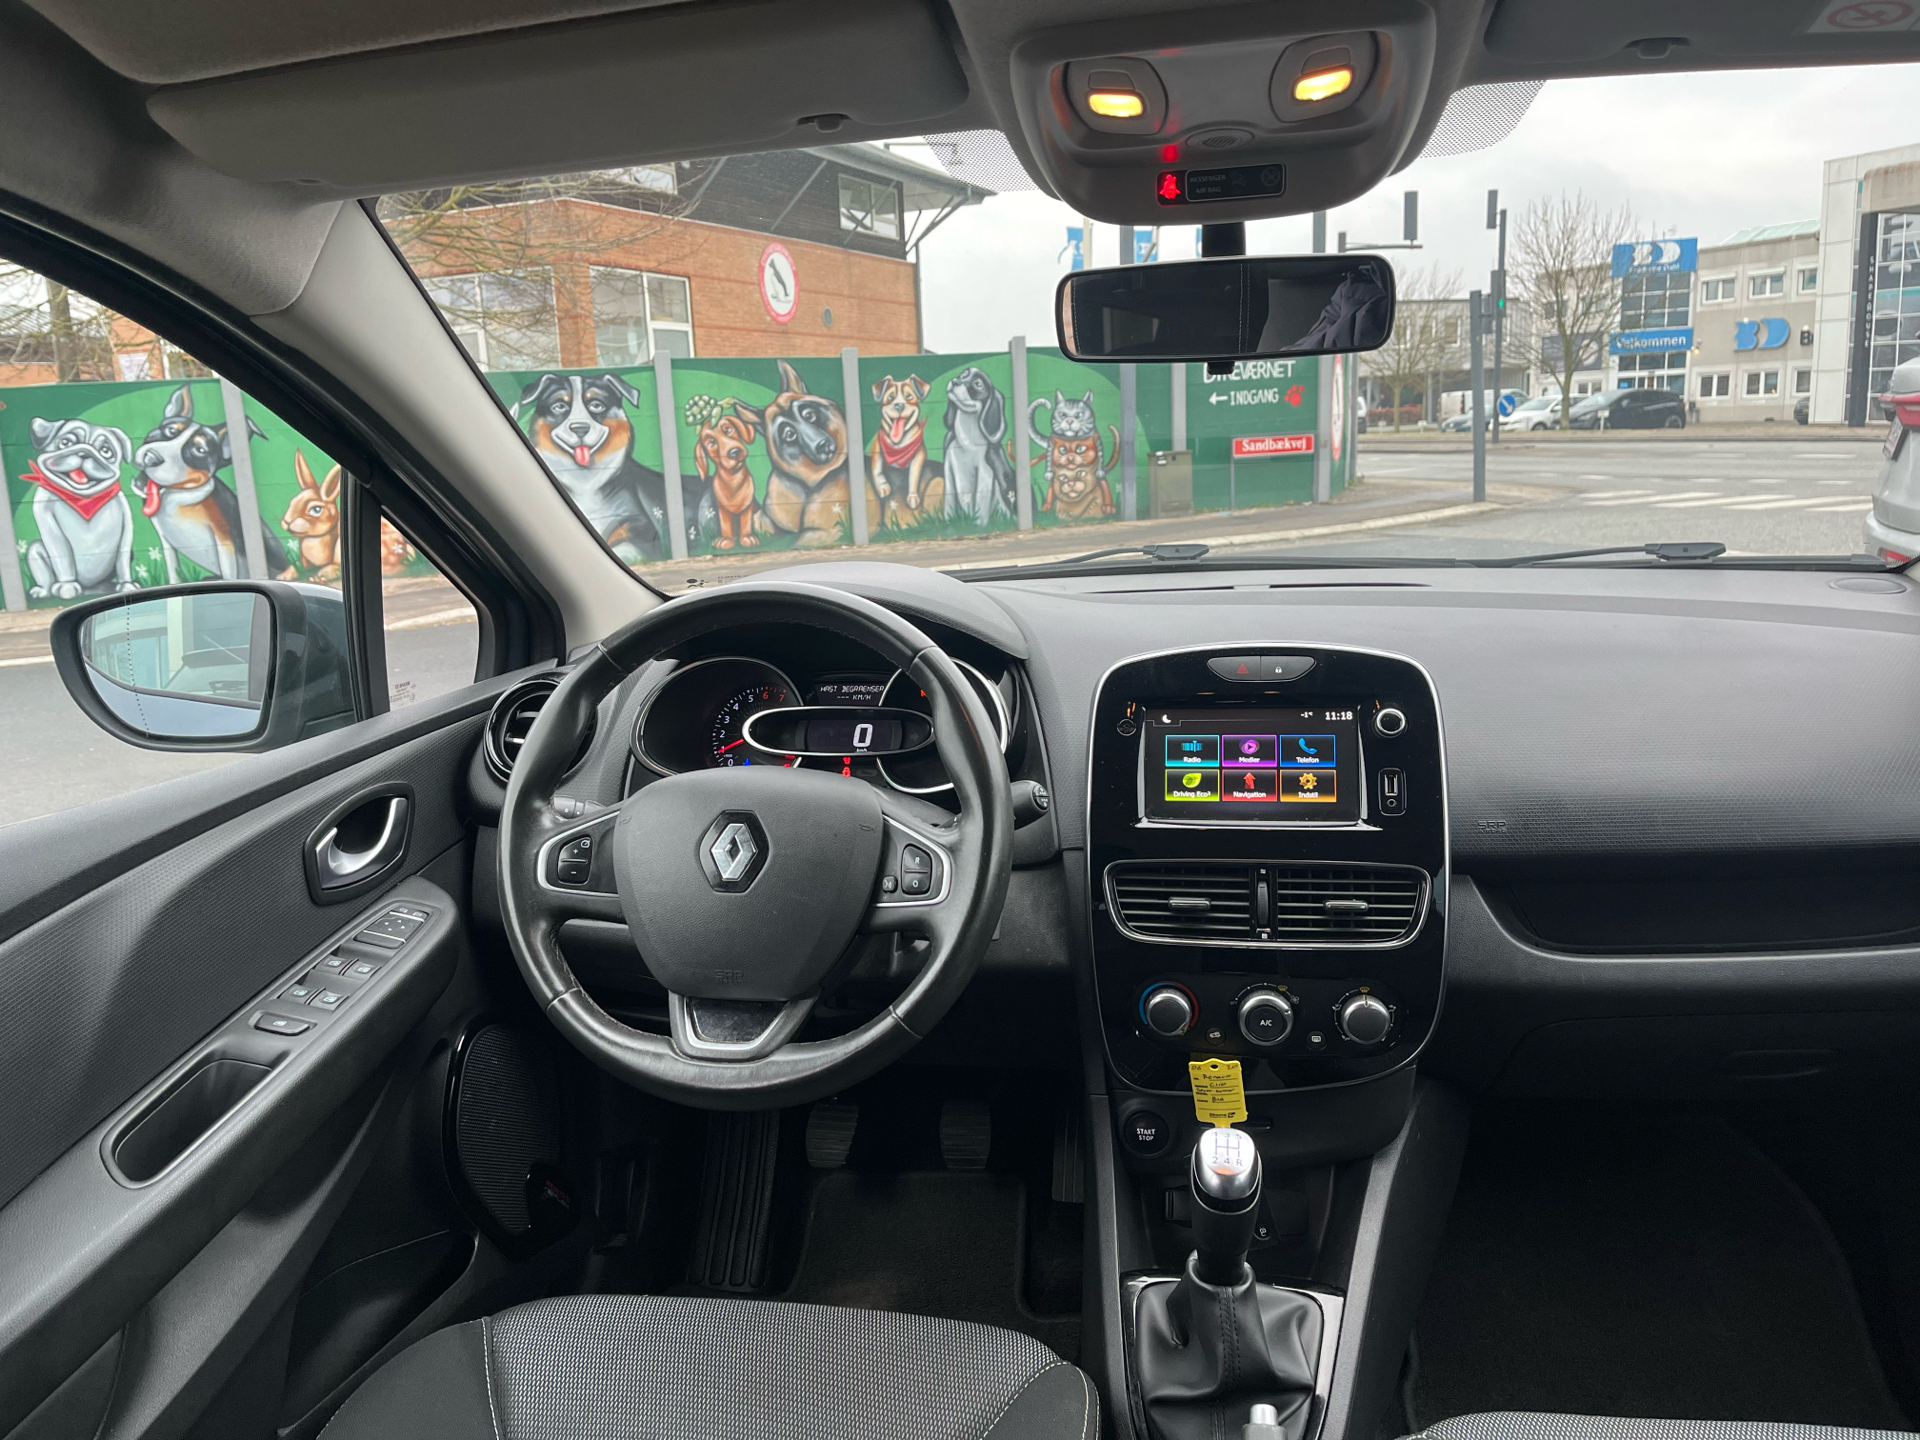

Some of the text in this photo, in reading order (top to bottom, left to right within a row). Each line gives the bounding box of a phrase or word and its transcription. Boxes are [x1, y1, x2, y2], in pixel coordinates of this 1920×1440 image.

[1190, 174, 1226, 183] PASSENGER
[1800, 331, 1813, 346] B
[1230, 388, 1279, 406] INDGANG
[1241, 437, 1307, 452] Sandbækvej
[1325, 711, 1353, 721] 11:18
[719, 730, 726, 738] 2
[852, 723, 873, 748] 0
[1173, 791, 1195, 799] Driving
[1233, 791, 1266, 799] Navigation
[1260, 1019, 1273, 1027] A/C
[1212, 1156, 1243, 1167] 2 4 R
